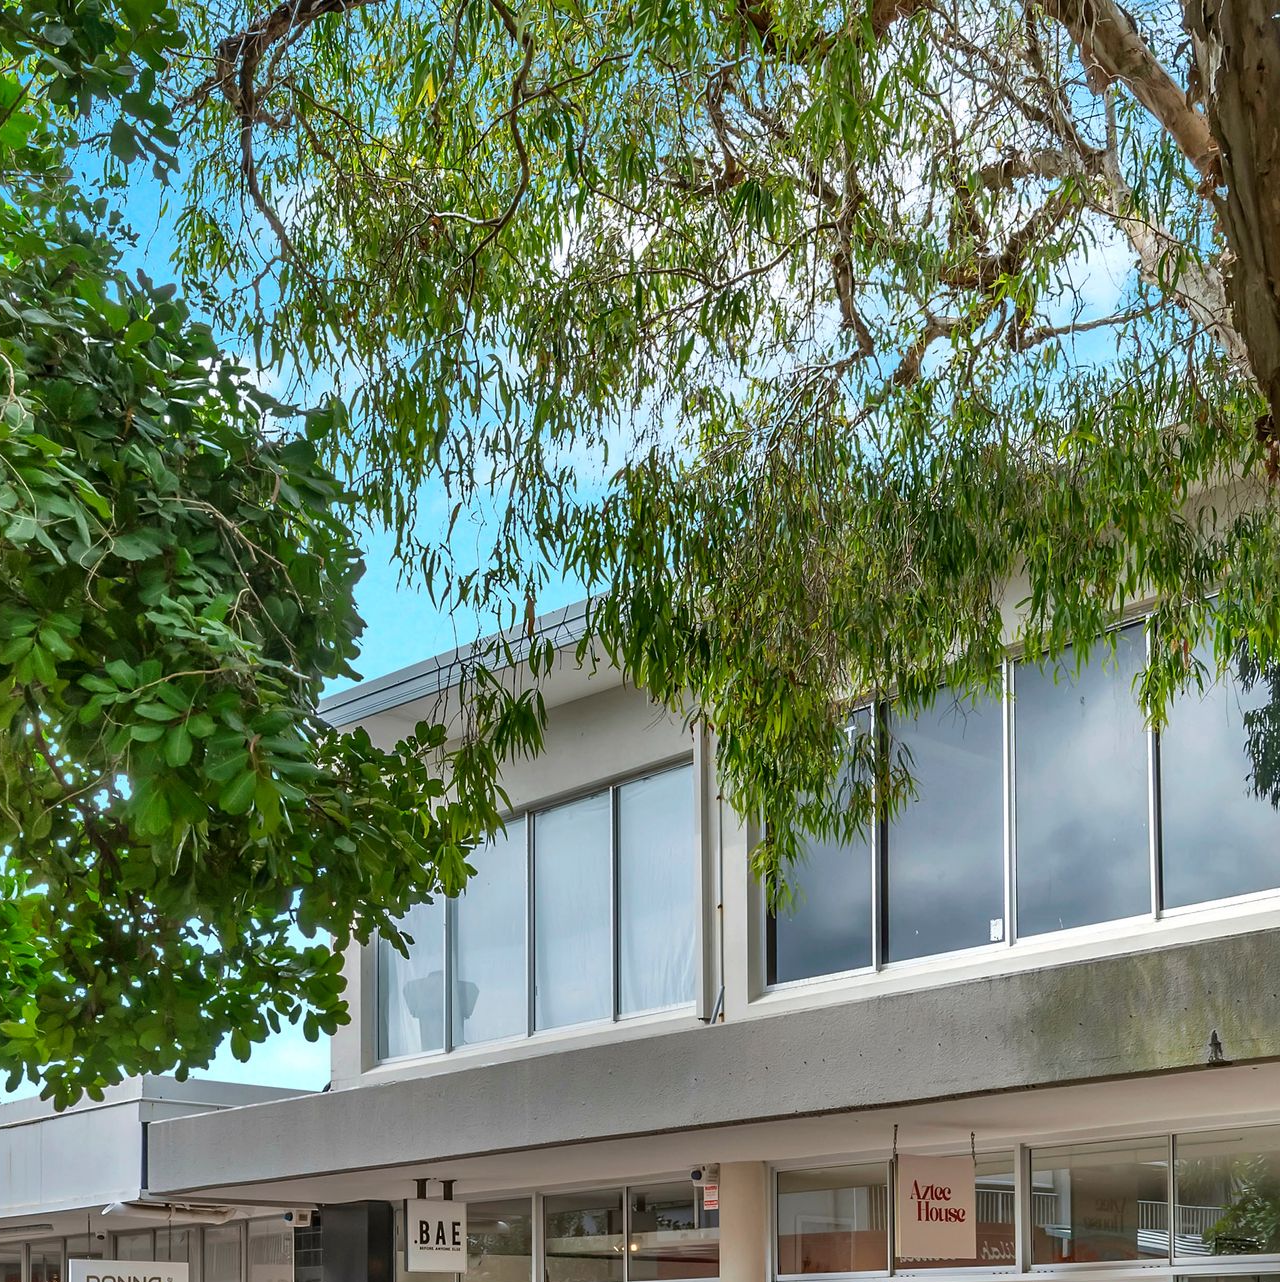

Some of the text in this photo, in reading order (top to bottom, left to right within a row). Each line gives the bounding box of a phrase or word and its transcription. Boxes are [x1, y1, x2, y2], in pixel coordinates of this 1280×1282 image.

[910, 1179, 951, 1201] Aztec
[917, 1201, 966, 1223] House
[414, 1219, 461, 1246] .BAE
